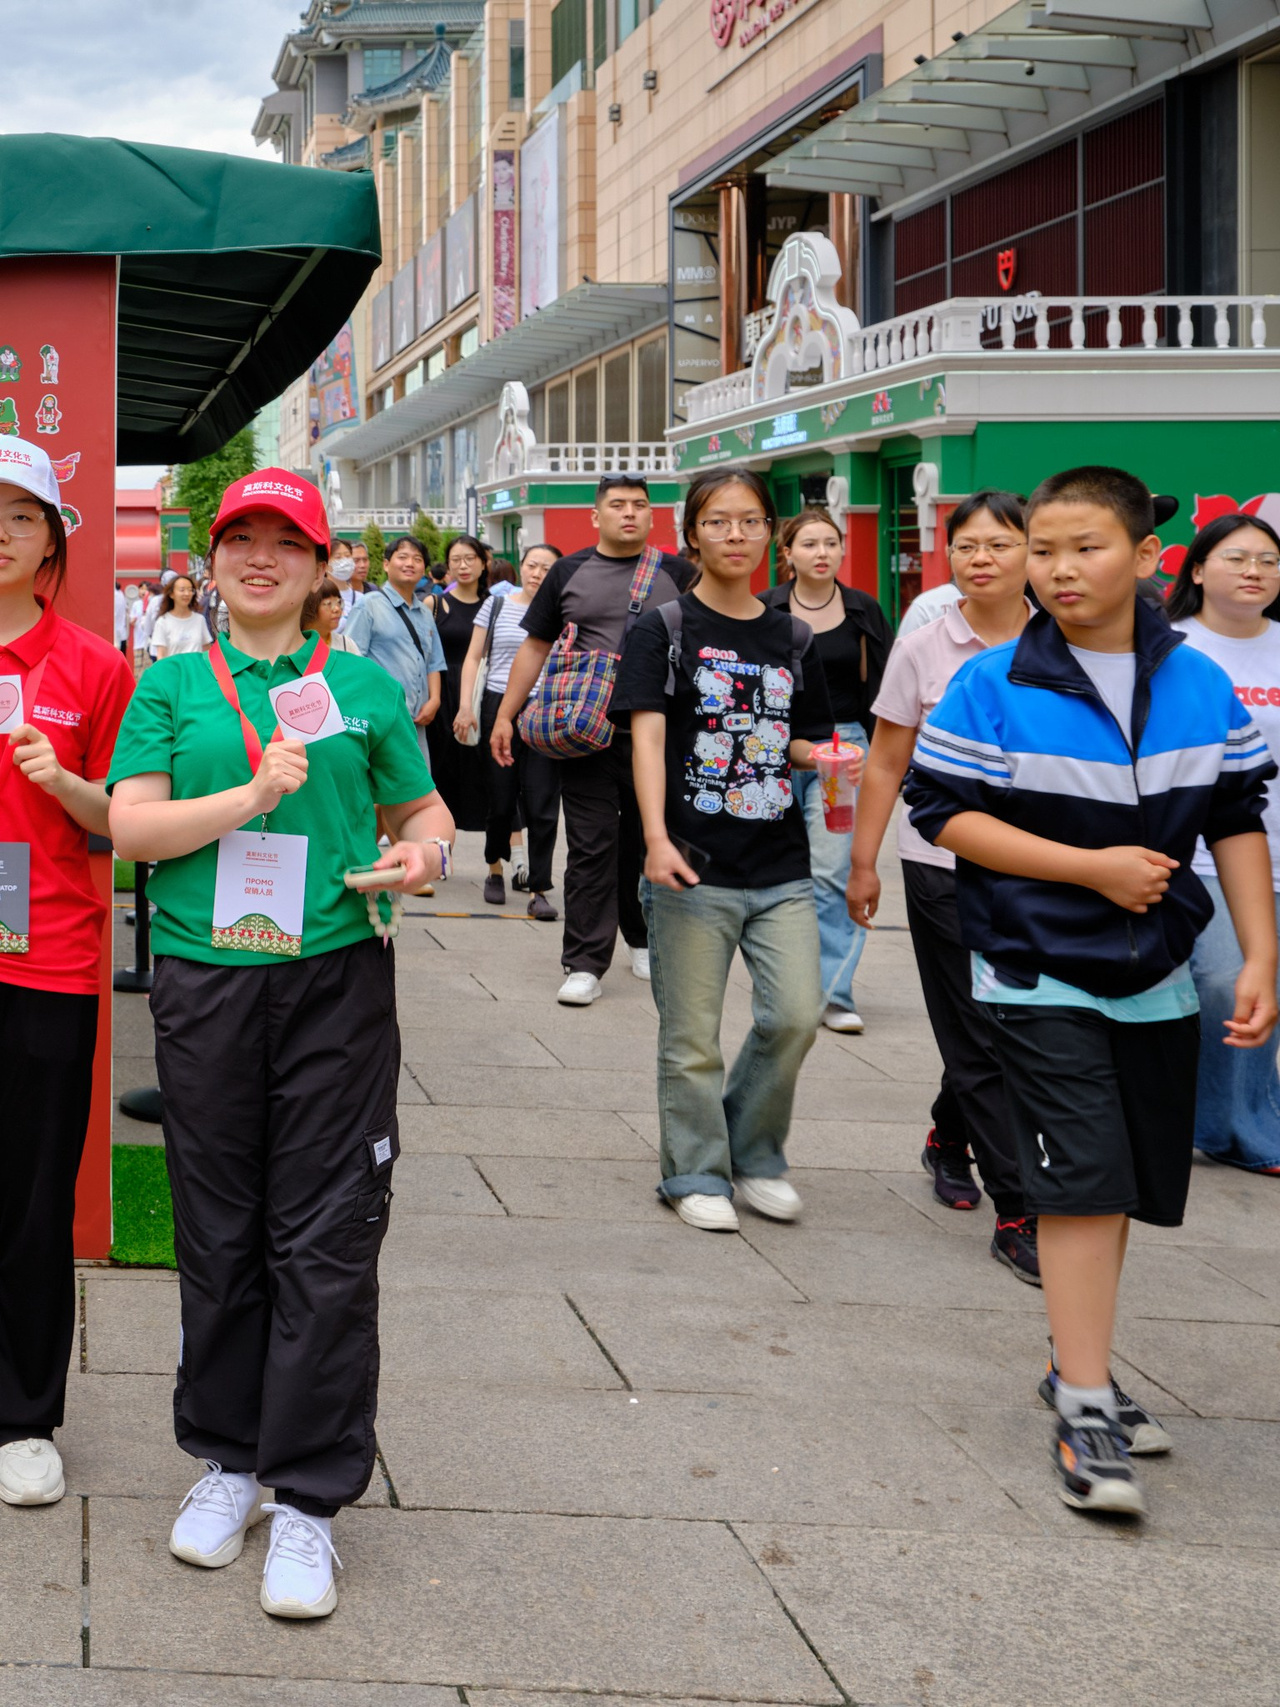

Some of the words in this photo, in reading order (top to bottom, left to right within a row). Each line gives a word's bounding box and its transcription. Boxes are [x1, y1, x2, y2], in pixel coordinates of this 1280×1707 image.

[768, 216, 796, 230] JYP
[243, 481, 304, 496] 莫斯科文化节
[703, 647, 738, 661] GOOD
[711, 659, 760, 676] LUCKY!
[33, 705, 82, 721] 莫斯科文化节
[245, 878, 273, 886] ПРОМО
[244, 887, 273, 896] 促销人员
